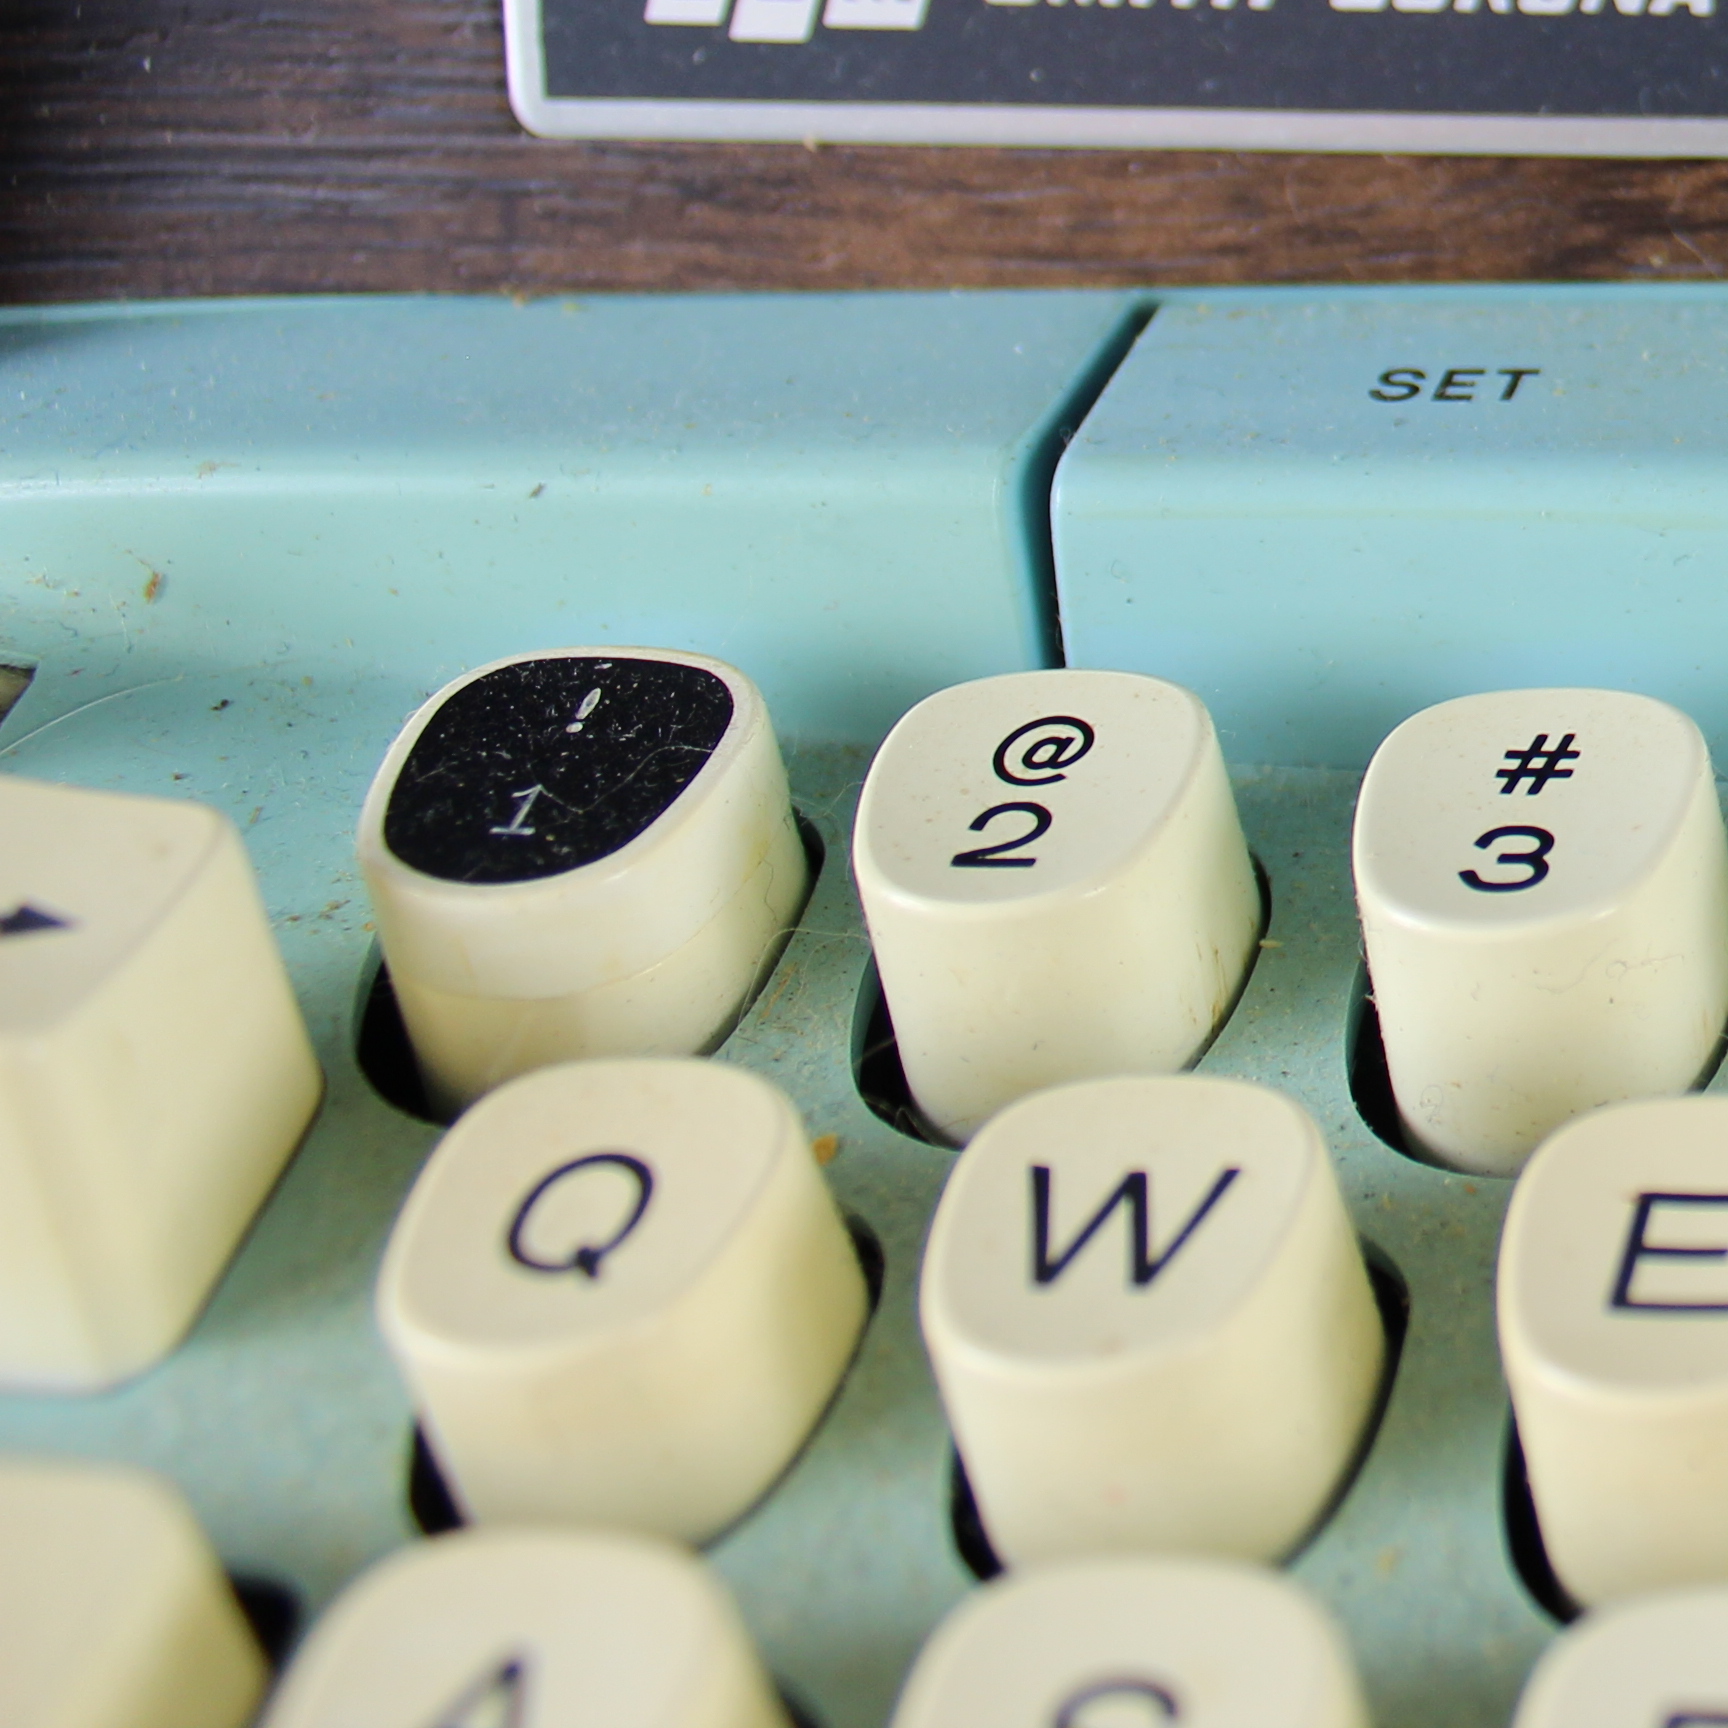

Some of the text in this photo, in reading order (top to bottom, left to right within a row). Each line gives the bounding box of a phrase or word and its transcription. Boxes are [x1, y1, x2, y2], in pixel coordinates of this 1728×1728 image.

[1367, 367, 1541, 403] SET
[992, 715, 1096, 788] @
[1494, 732, 1582, 797] #
[488, 782, 545, 837] 1
[949, 800, 1054, 869] 2
[1457, 824, 1556, 894] 3
[503, 1151, 656, 1282] Q
[1029, 1163, 1241, 1290] W
